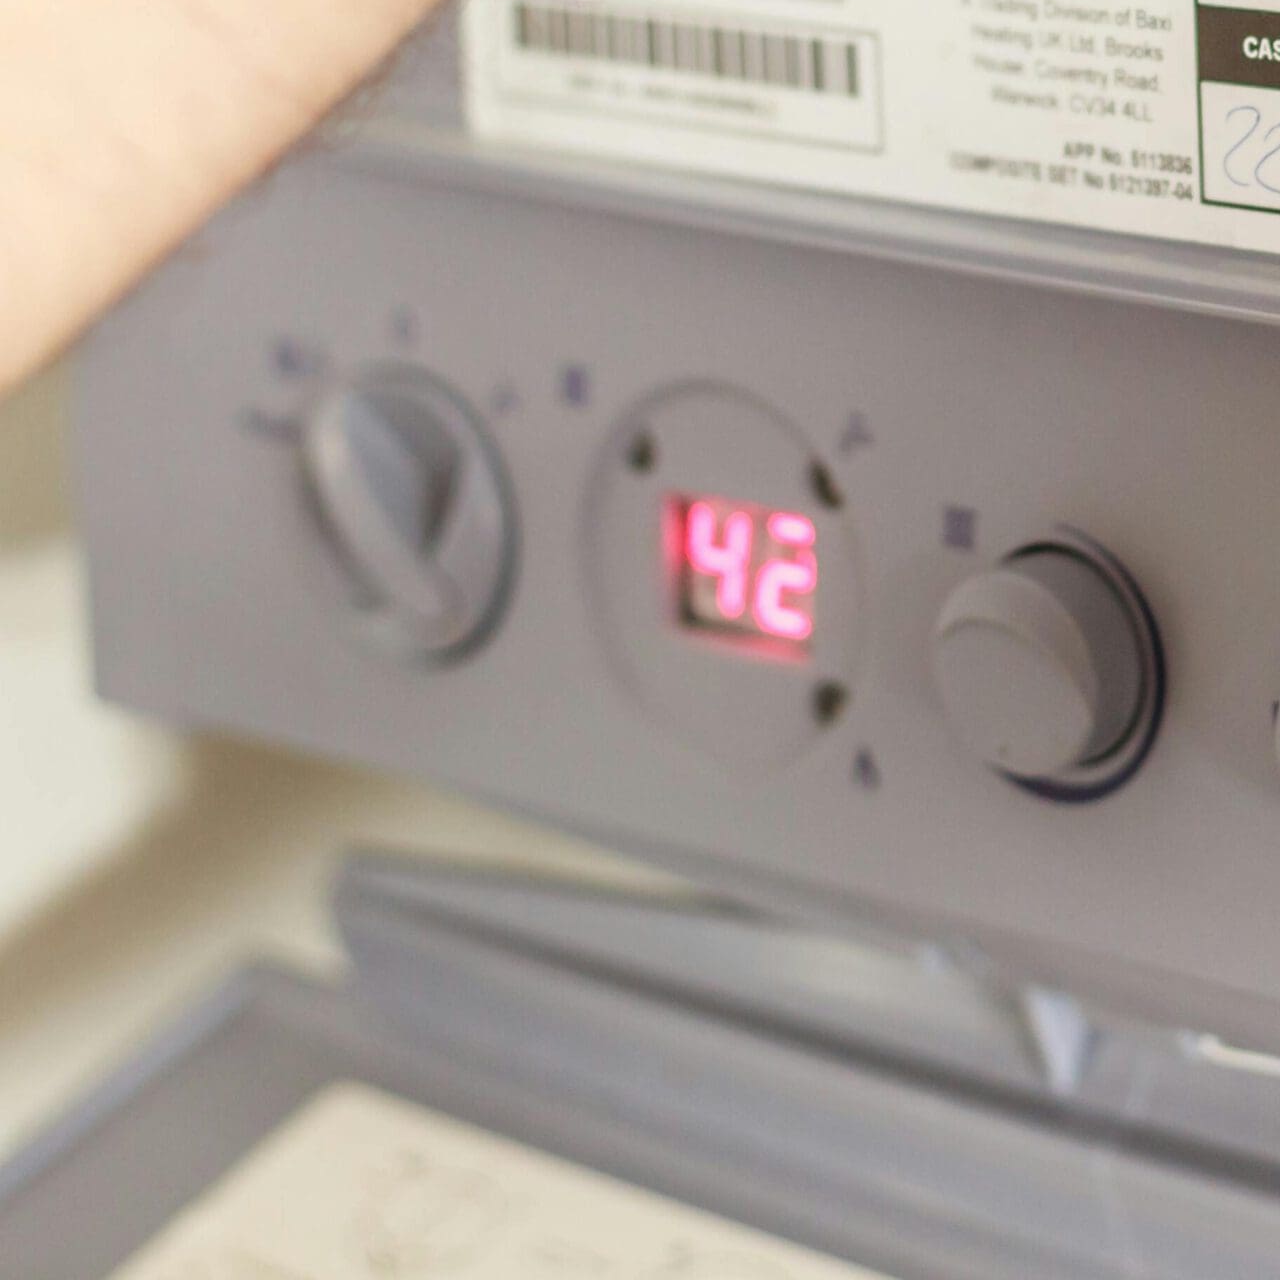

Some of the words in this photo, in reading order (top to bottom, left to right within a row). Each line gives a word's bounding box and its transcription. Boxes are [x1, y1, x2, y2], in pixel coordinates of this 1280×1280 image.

[1115, 9, 1131, 26] of
[1136, 9, 1172, 32] Baxi
[1105, 36, 1164, 63] Brooks
[686, 500, 818, 641] 42
